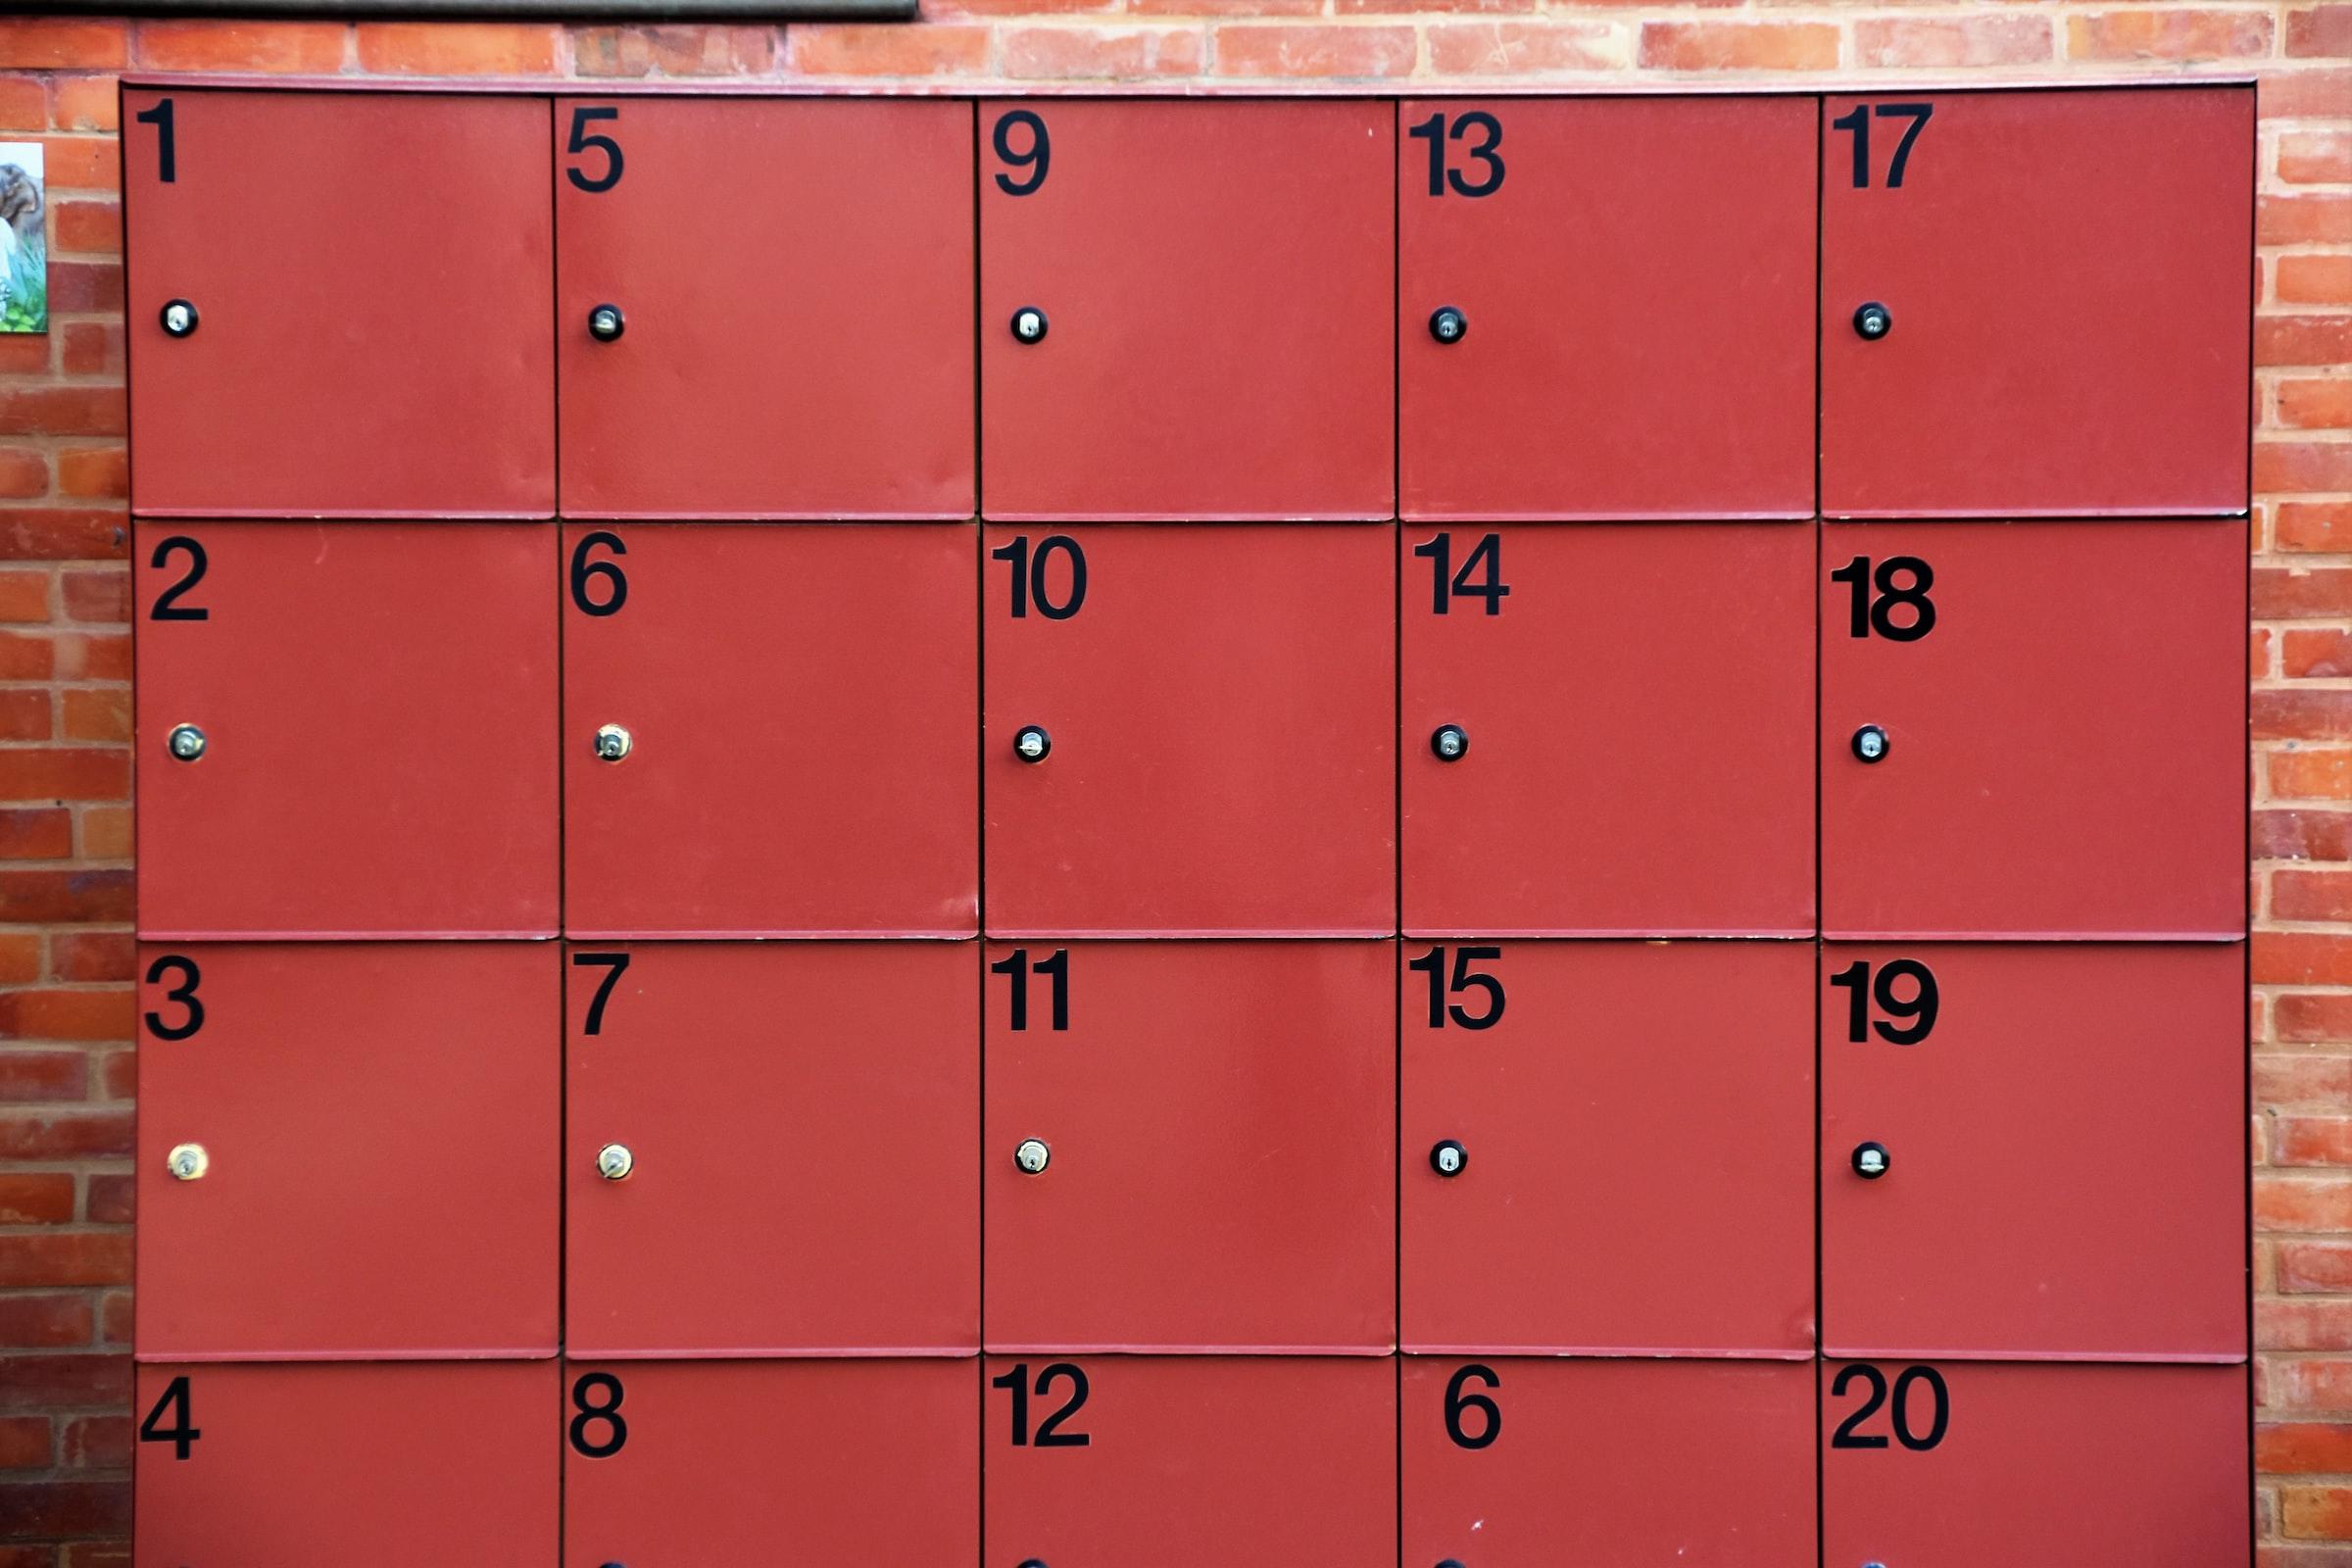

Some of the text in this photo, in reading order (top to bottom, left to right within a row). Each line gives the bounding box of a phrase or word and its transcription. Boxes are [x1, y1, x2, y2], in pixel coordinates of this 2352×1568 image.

[136, 98, 175, 183] 1
[566, 107, 624, 193] 5
[993, 110, 1051, 197] 9
[1409, 111, 1505, 198] 13
[1833, 103, 1934, 188] 17
[150, 535, 209, 621] 2
[570, 531, 628, 617] 6
[992, 535, 1088, 620] 10
[1414, 532, 1510, 615] 14
[1831, 556, 1936, 643] 18
[144, 954, 205, 1042] 3
[572, 953, 630, 1036] 7
[991, 949, 1068, 1031] 11
[1409, 946, 1506, 1031] 15
[1830, 958, 1939, 1046] 19
[139, 1375, 202, 1461] 4
[568, 1370, 628, 1458] 8
[992, 1362, 1090, 1447] 12
[1444, 1363, 1501, 1450] 6
[1831, 1364, 1950, 1450] 20
